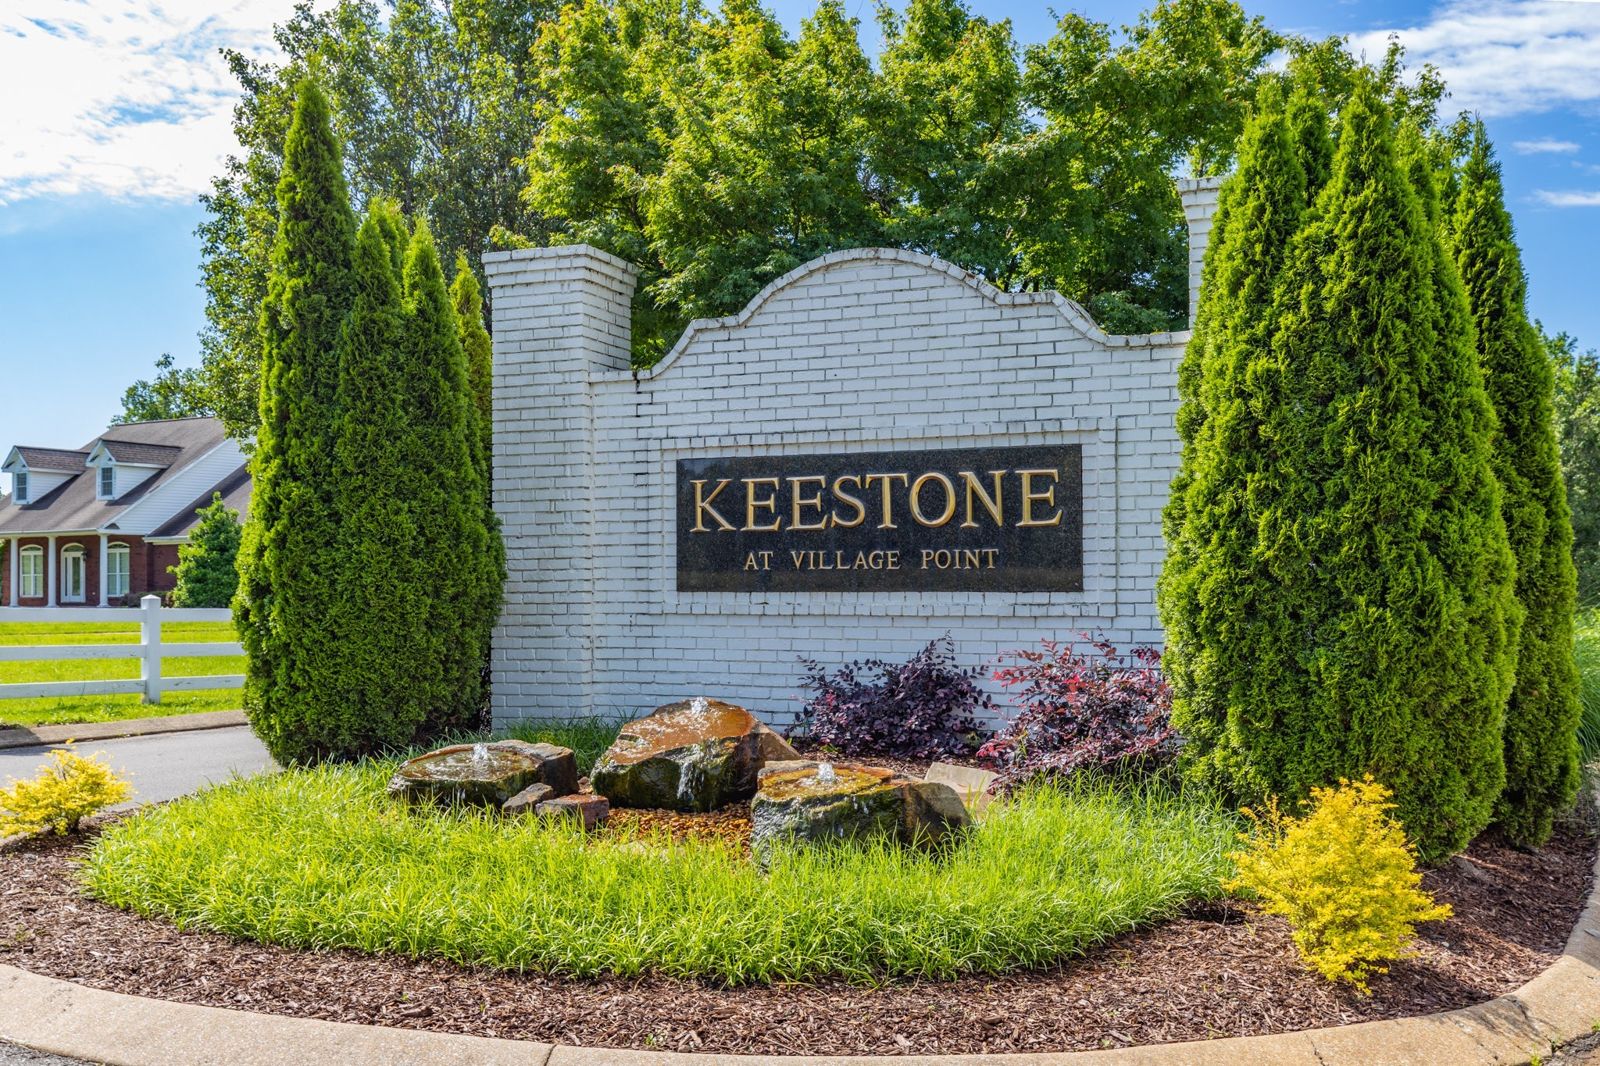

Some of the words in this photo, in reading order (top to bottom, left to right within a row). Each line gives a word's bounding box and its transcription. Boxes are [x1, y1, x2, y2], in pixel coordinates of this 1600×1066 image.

[689, 468, 1063, 533] KEESTONE
[743, 551, 774, 571] AT
[790, 549, 900, 570] VILLAGE
[920, 548, 999, 570] POINT
